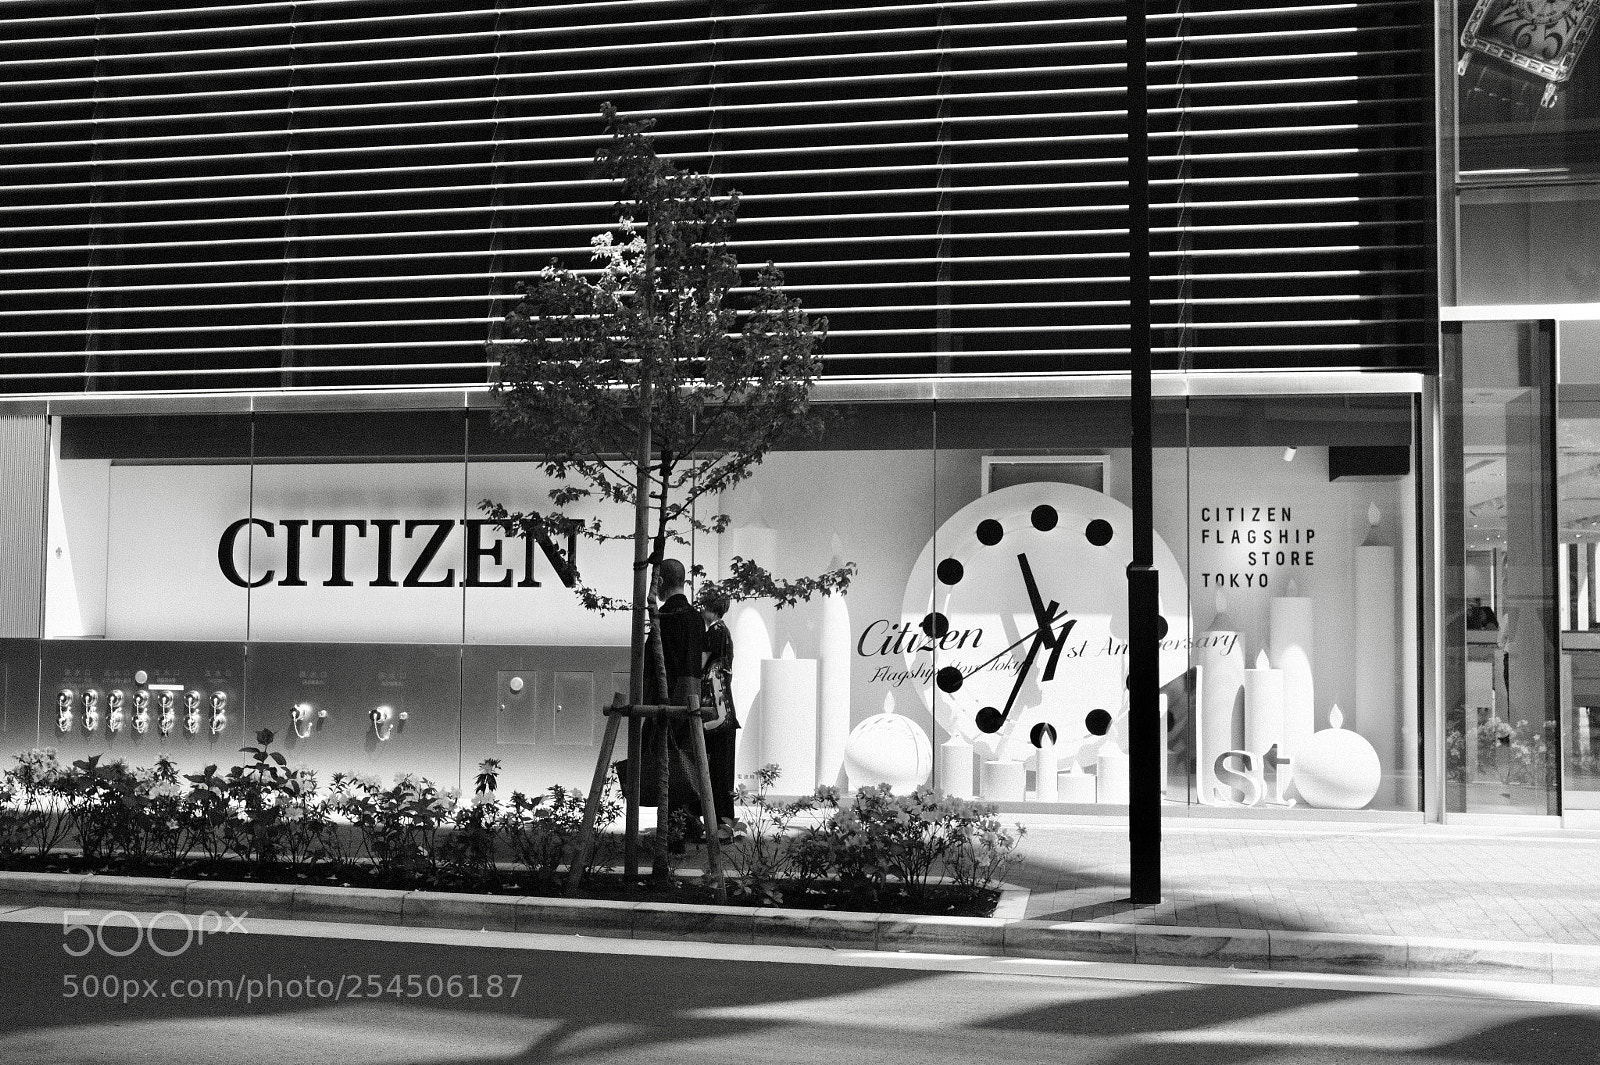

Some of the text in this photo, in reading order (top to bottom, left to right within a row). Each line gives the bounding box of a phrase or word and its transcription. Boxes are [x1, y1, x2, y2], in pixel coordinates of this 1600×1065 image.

[1201, 507, 1292, 522] CITIZEN
[1201, 529, 1316, 544] FLAGSHIP
[217, 517, 585, 588] CITIZEN
[1247, 551, 1315, 566] STORE
[1201, 573, 1269, 588] TOKYO
